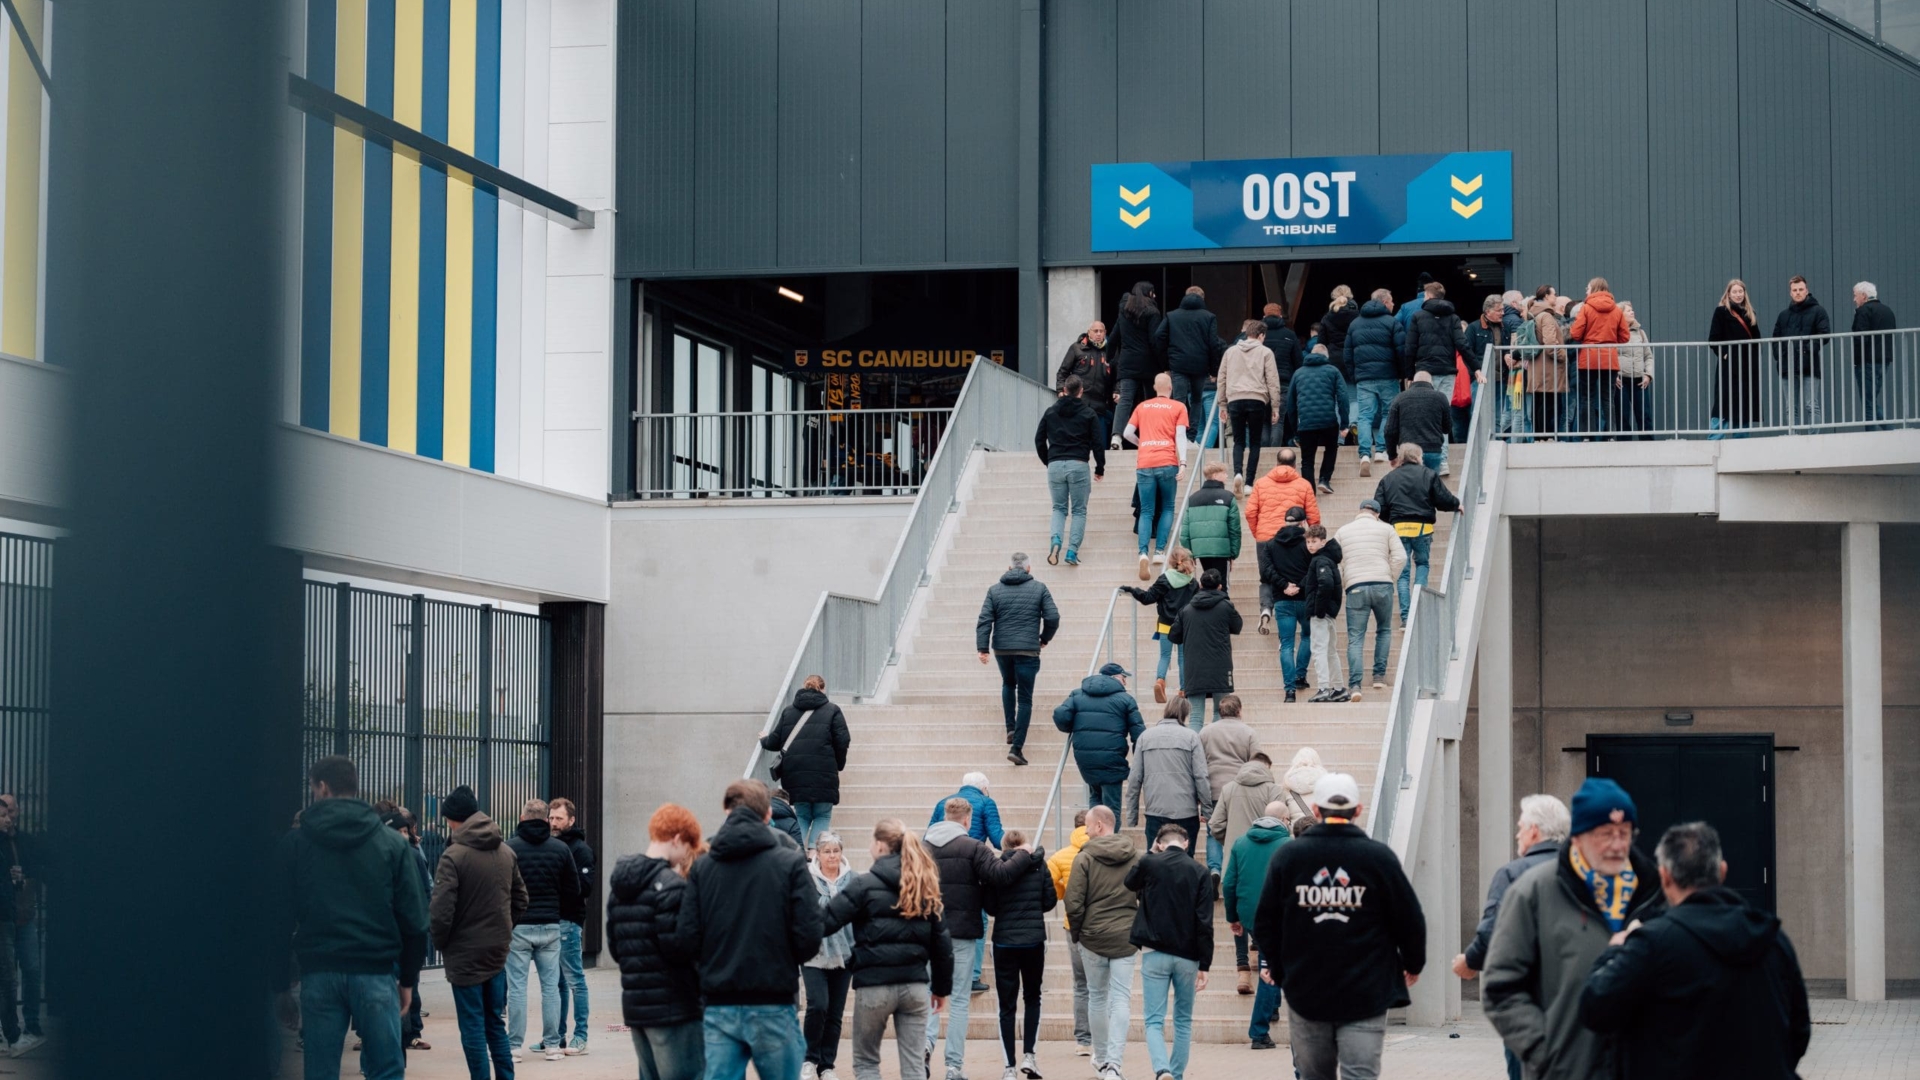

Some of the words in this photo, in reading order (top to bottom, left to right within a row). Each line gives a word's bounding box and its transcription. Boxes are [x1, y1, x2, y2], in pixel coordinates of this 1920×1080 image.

[1243, 171, 1356, 220] OOST
[1263, 224, 1337, 235] TRIBUNE
[821, 349, 853, 368] SC
[858, 349, 977, 368] CAMBUUR
[1295, 885, 1367, 907] TOMMY
